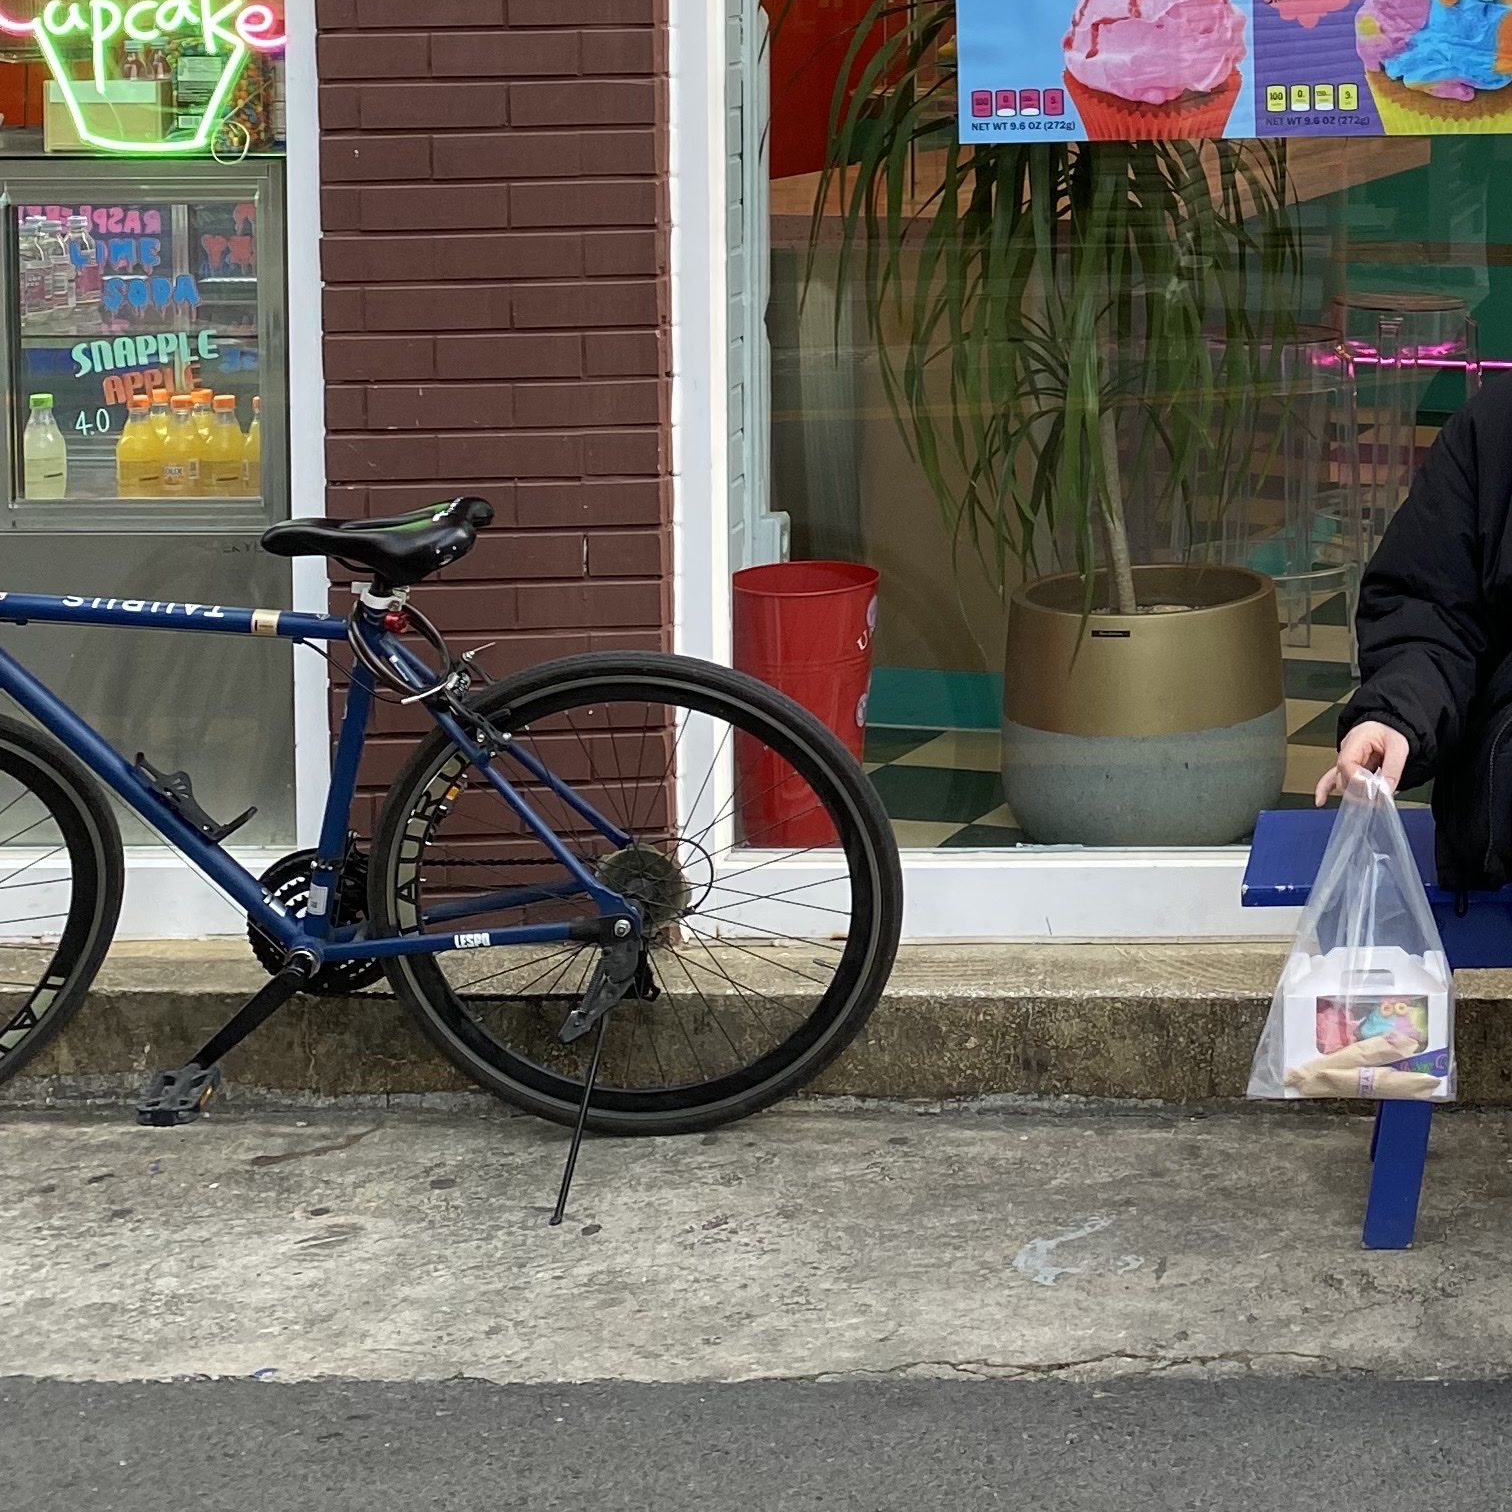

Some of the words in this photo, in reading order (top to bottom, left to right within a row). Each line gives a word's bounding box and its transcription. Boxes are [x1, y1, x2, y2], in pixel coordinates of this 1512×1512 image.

[971, 122, 990, 131] NET
[993, 122, 1008, 130] WT
[1028, 121, 1041, 129] OZ
[1265, 117, 1284, 126] NET
[1287, 116, 1302, 125] WT
[1322, 116, 1336, 124] OZ
[69, 238, 162, 271] LIME
[104, 273, 201, 316] SODA
[71, 329, 220, 378] SNAPPLE
[103, 363, 202, 406] APPLE
[75, 408, 111, 437] 4.0
[454, 932, 491, 949] LESPO
